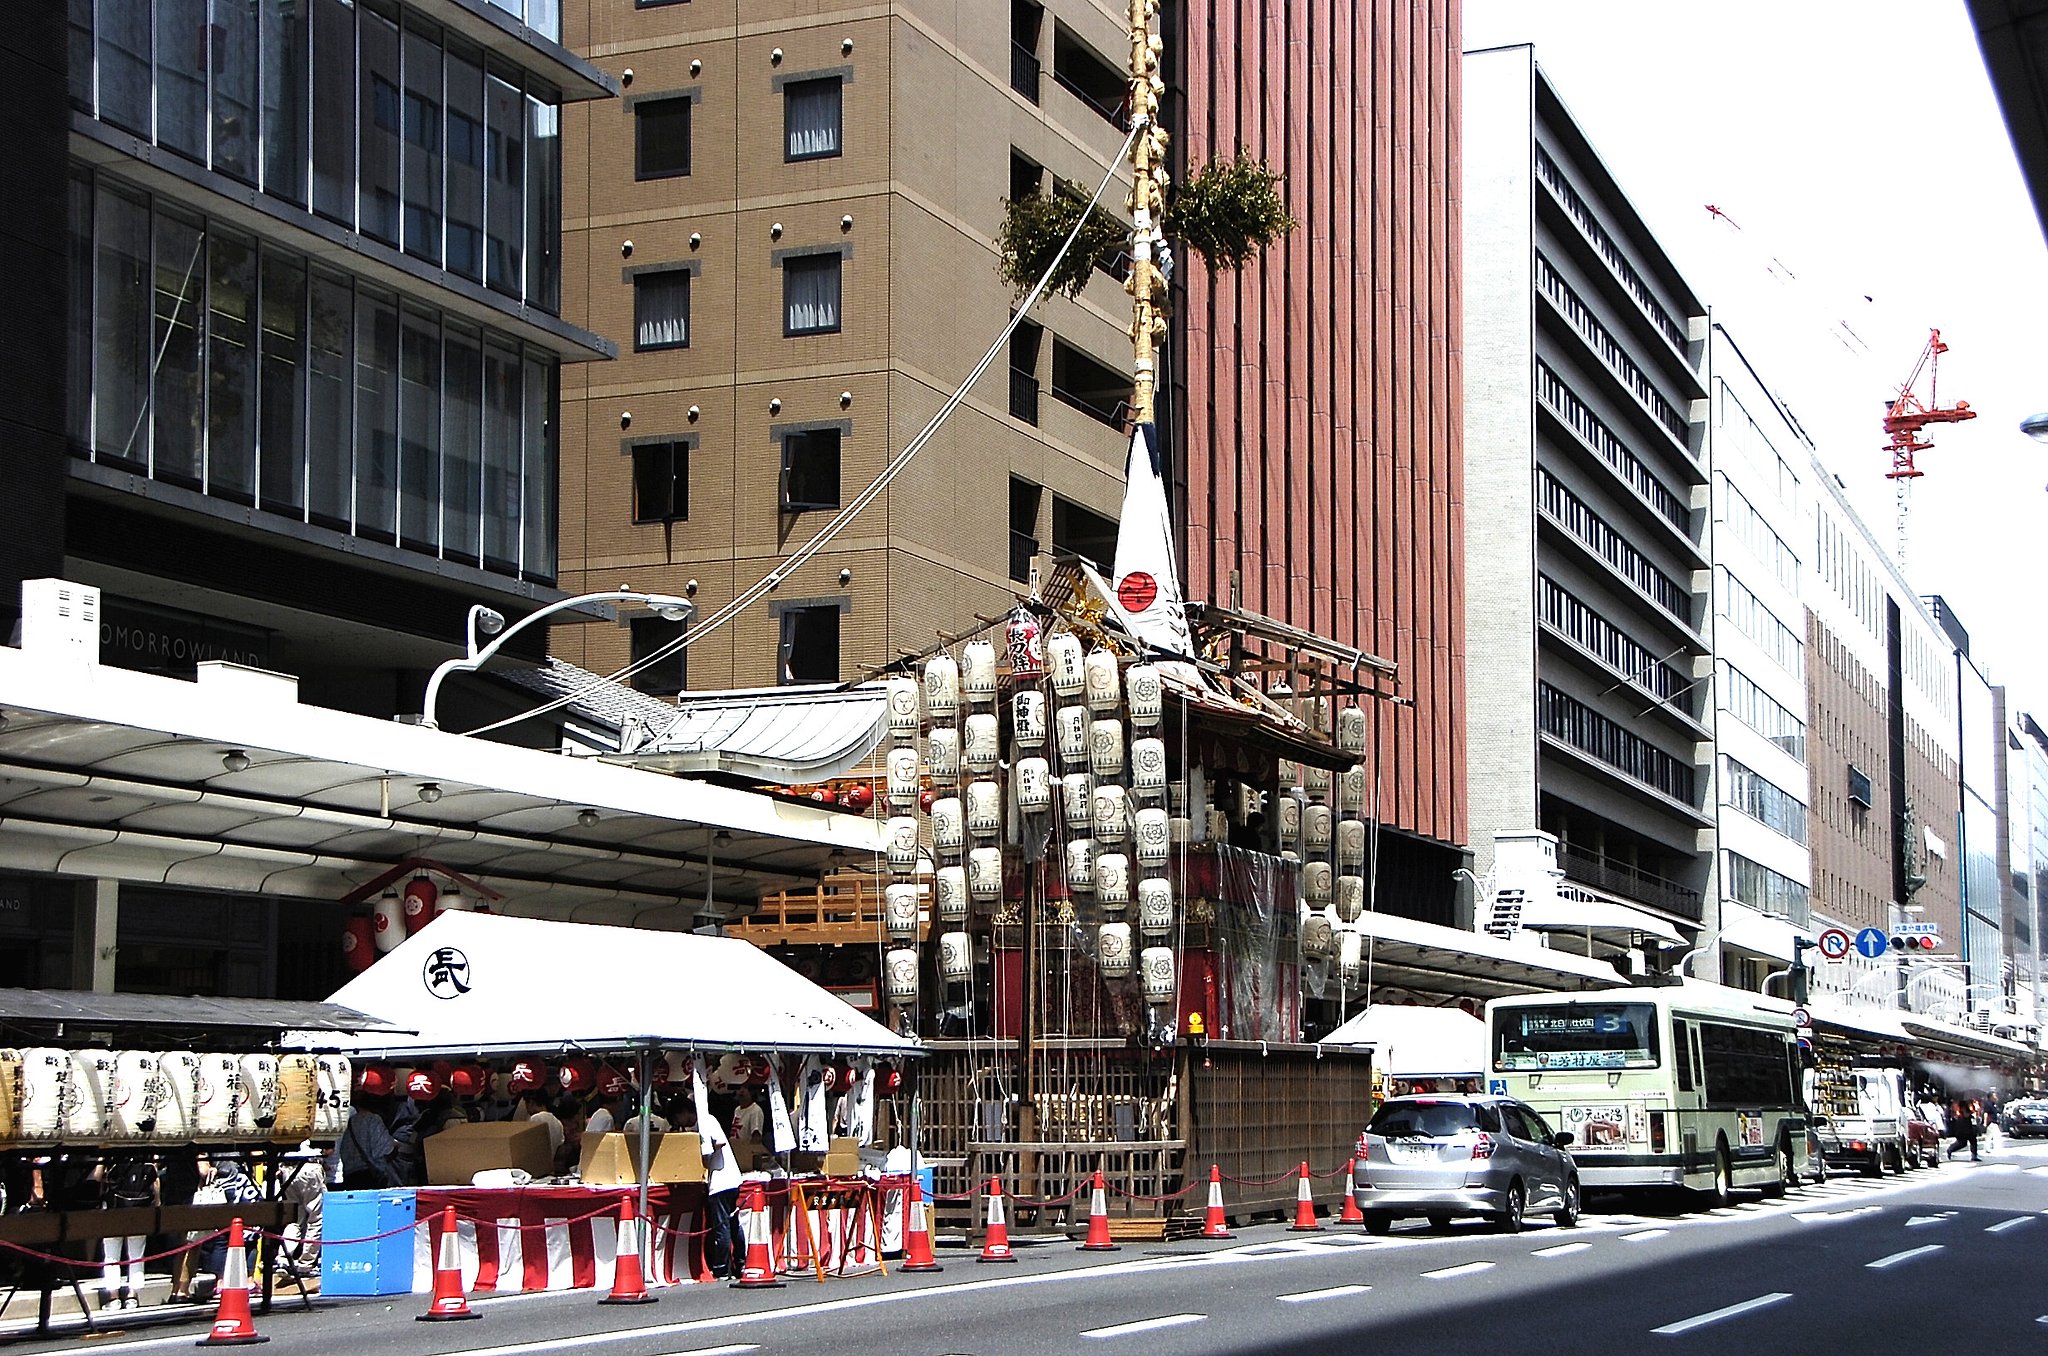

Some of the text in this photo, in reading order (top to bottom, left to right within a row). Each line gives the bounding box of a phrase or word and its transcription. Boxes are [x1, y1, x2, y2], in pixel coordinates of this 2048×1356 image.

[1009, 627, 1029, 672] 長刀鉾
[1602, 1013, 1620, 1031] 3
